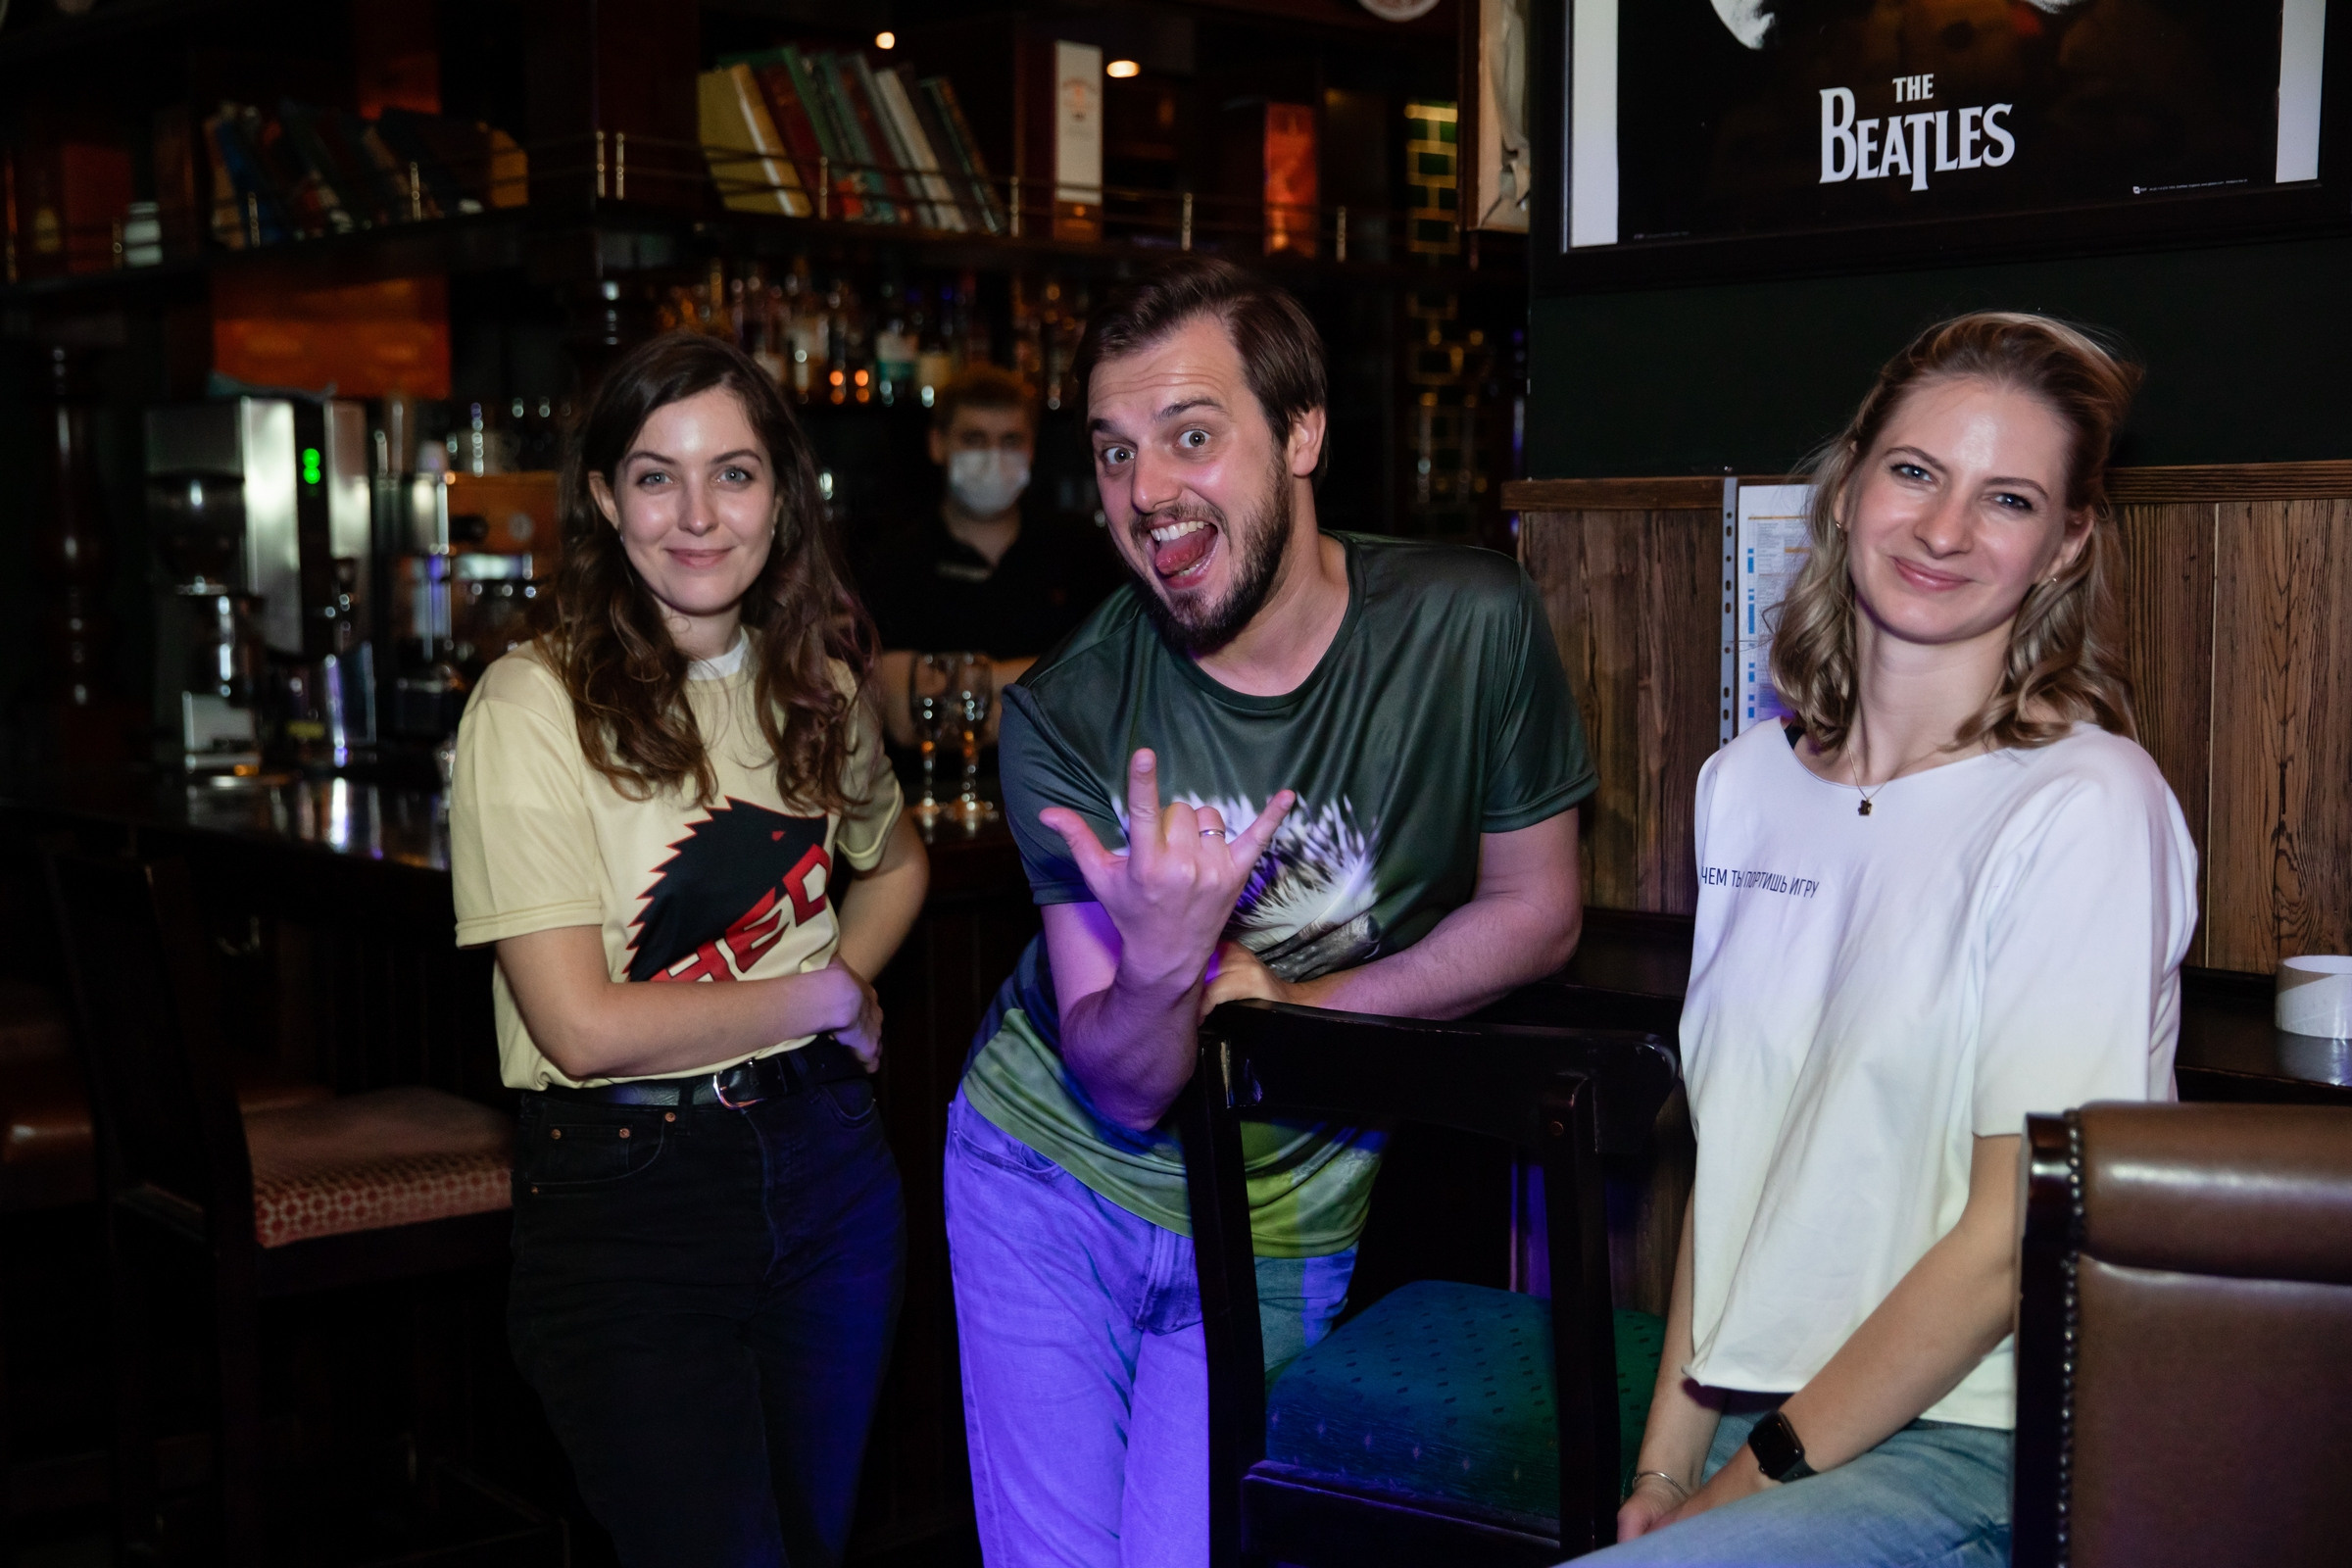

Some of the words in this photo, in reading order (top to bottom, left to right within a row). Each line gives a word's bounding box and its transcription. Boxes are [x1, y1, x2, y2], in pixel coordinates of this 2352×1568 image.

[1892, 74, 1935, 104] THE
[1819, 86, 2016, 192] BEATLES
[1701, 865, 1728, 887] ЧЕМ
[1731, 869, 1745, 888] ТЫ
[1743, 870, 1788, 894] ПОРТИШЬ
[1788, 877, 1820, 899] ИГРУ
